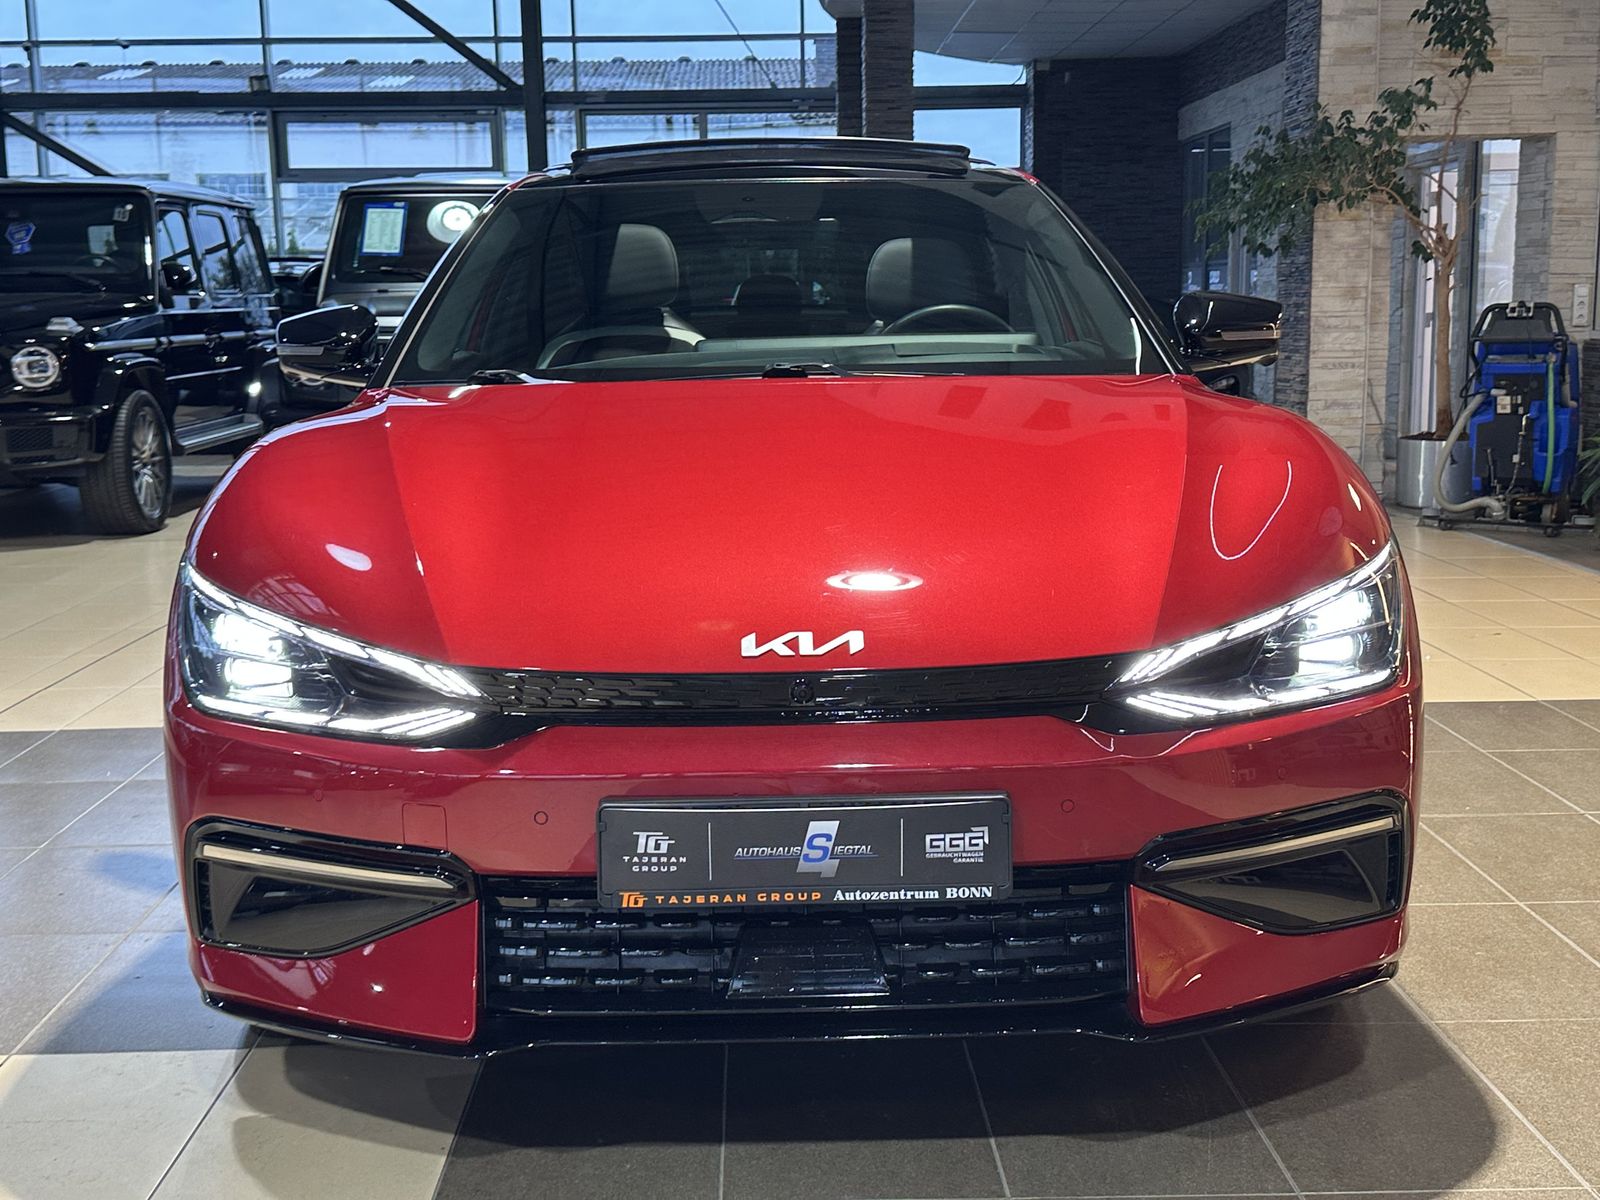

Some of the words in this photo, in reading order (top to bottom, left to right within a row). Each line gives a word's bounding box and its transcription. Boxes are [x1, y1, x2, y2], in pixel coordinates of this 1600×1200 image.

[734, 846, 801, 857] AUTOHAUS
[802, 833, 873, 863] SIEGTAL
[925, 831, 984, 852] GGG
[655, 894, 747, 904] TAJERAN
[757, 892, 822, 902] GROUP
[833, 889, 939, 901] Autozentrum
[945, 886, 993, 899] BONN
